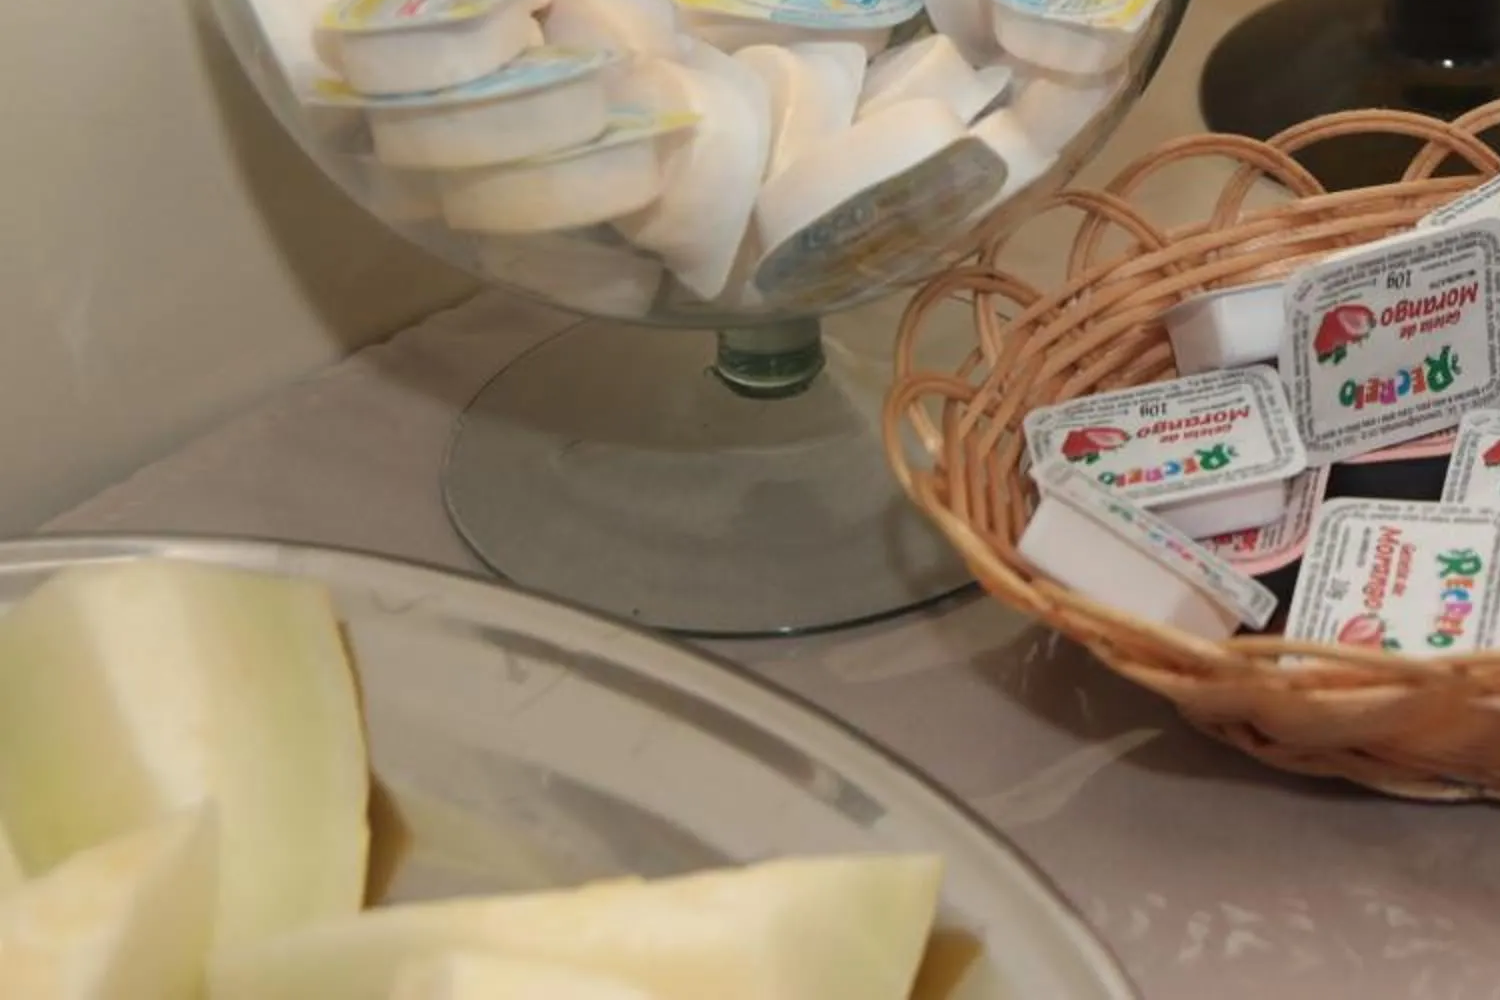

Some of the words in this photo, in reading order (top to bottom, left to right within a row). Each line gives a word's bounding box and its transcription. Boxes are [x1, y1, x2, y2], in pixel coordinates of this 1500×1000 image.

[1386, 269, 1411, 290] 10g
[1381, 282, 1480, 327] Morango
[1399, 324, 1417, 340] de
[1339, 345, 1461, 410] RECREIO
[1136, 405, 1250, 440] Morango
[1139, 402, 1167, 419] 10g
[1098, 443, 1238, 487] RECREIO
[1362, 526, 1402, 610] Morango
[1427, 549, 1483, 648] RECREIO
